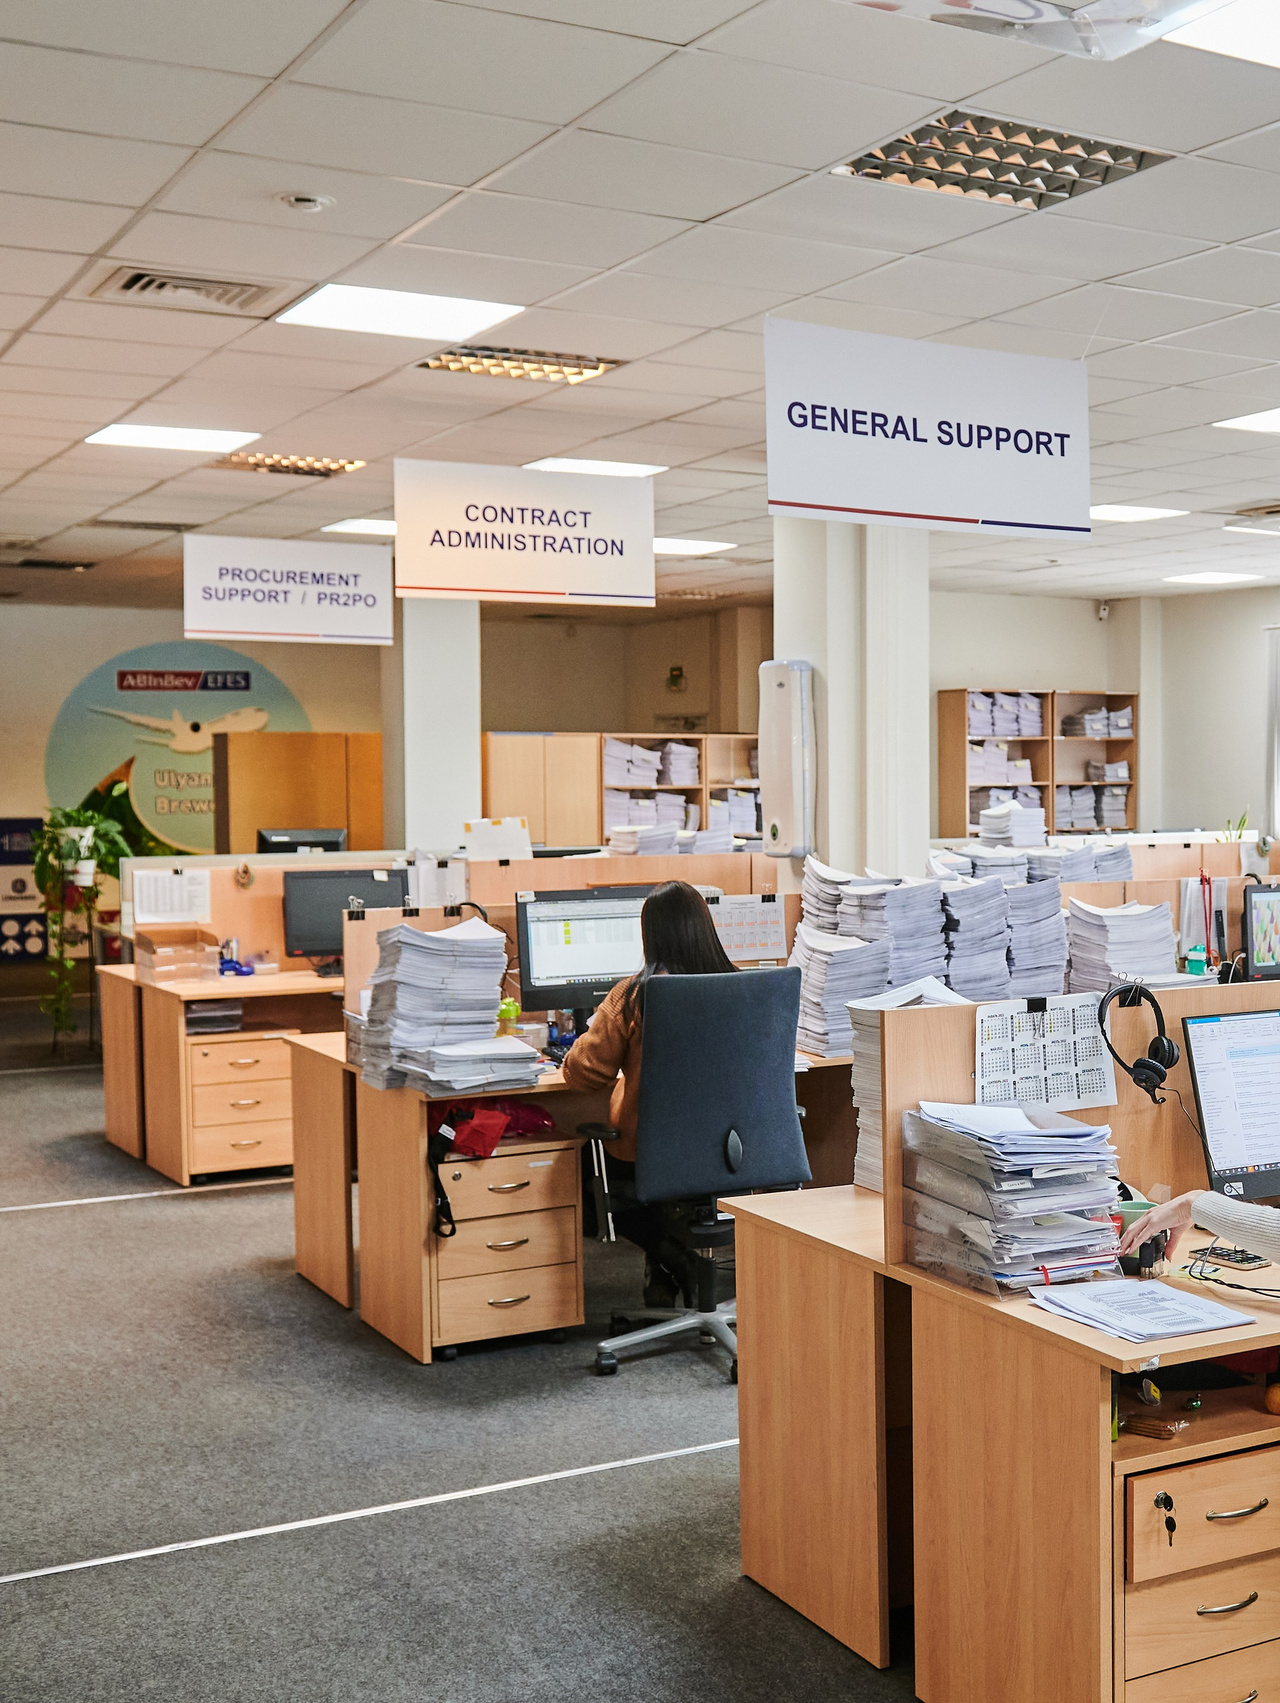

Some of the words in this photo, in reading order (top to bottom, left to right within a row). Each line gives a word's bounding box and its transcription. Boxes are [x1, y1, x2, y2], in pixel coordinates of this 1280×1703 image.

[787, 401, 928, 443] GENERAL
[936, 420, 1070, 457] SUPPORT
[465, 504, 591, 529] CONTRACT
[430, 530, 624, 556] ADMINISTRATION
[218, 566, 361, 587] PROCUREMENT
[201, 586, 290, 604] SUPPORT
[317, 592, 377, 608] PR2PO
[206, 673, 246, 688] EFES
